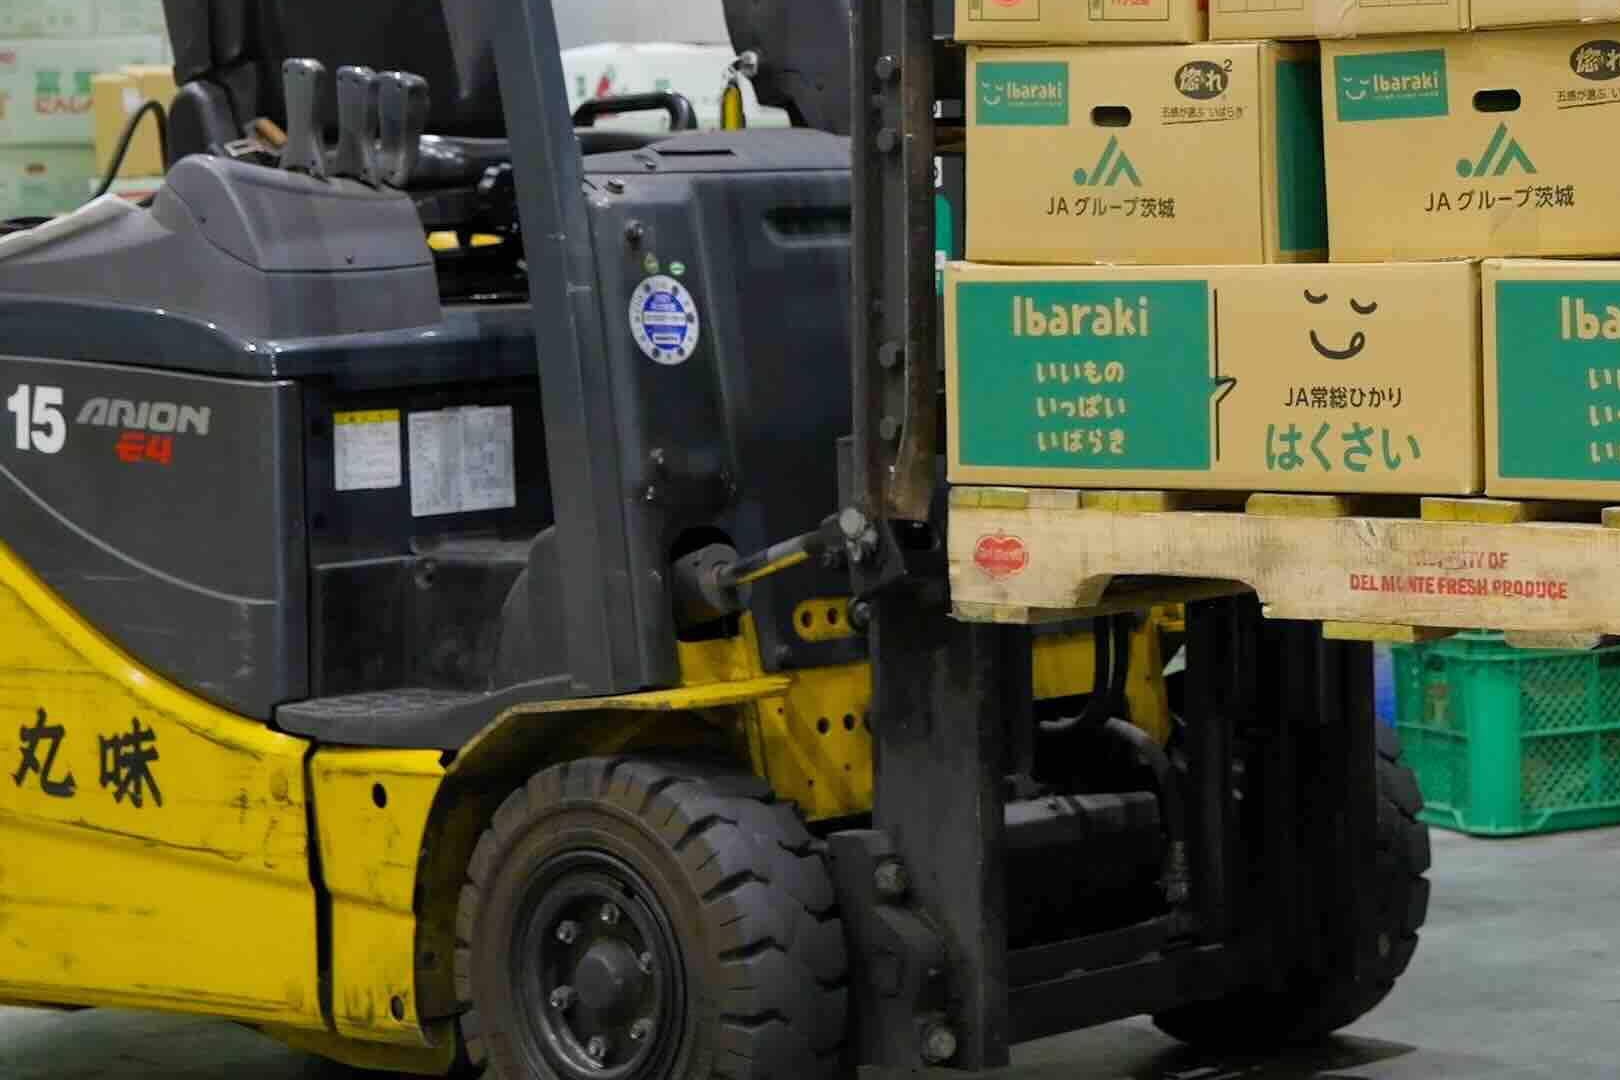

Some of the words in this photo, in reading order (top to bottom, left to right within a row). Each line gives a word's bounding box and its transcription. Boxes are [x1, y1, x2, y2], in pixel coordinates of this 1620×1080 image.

[1007, 83, 1063, 103] Ibaraki
[1372, 72, 1440, 95] Ibaraki
[1013, 296, 1149, 336] Ibaraki
[1035, 362, 1125, 384] いいもの
[1284, 387, 1402, 409] JA常総ひかり
[8, 384, 66, 454] 15
[1038, 430, 1126, 454] いばらき
[1265, 422, 1421, 473] はくさい
[1351, 574, 1378, 591] DEL
[1381, 575, 1434, 593] MNTE
[1438, 577, 1487, 596] FRESH
[1493, 580, 1568, 599] PRODUCE
[13, 708, 163, 808] 丸味
